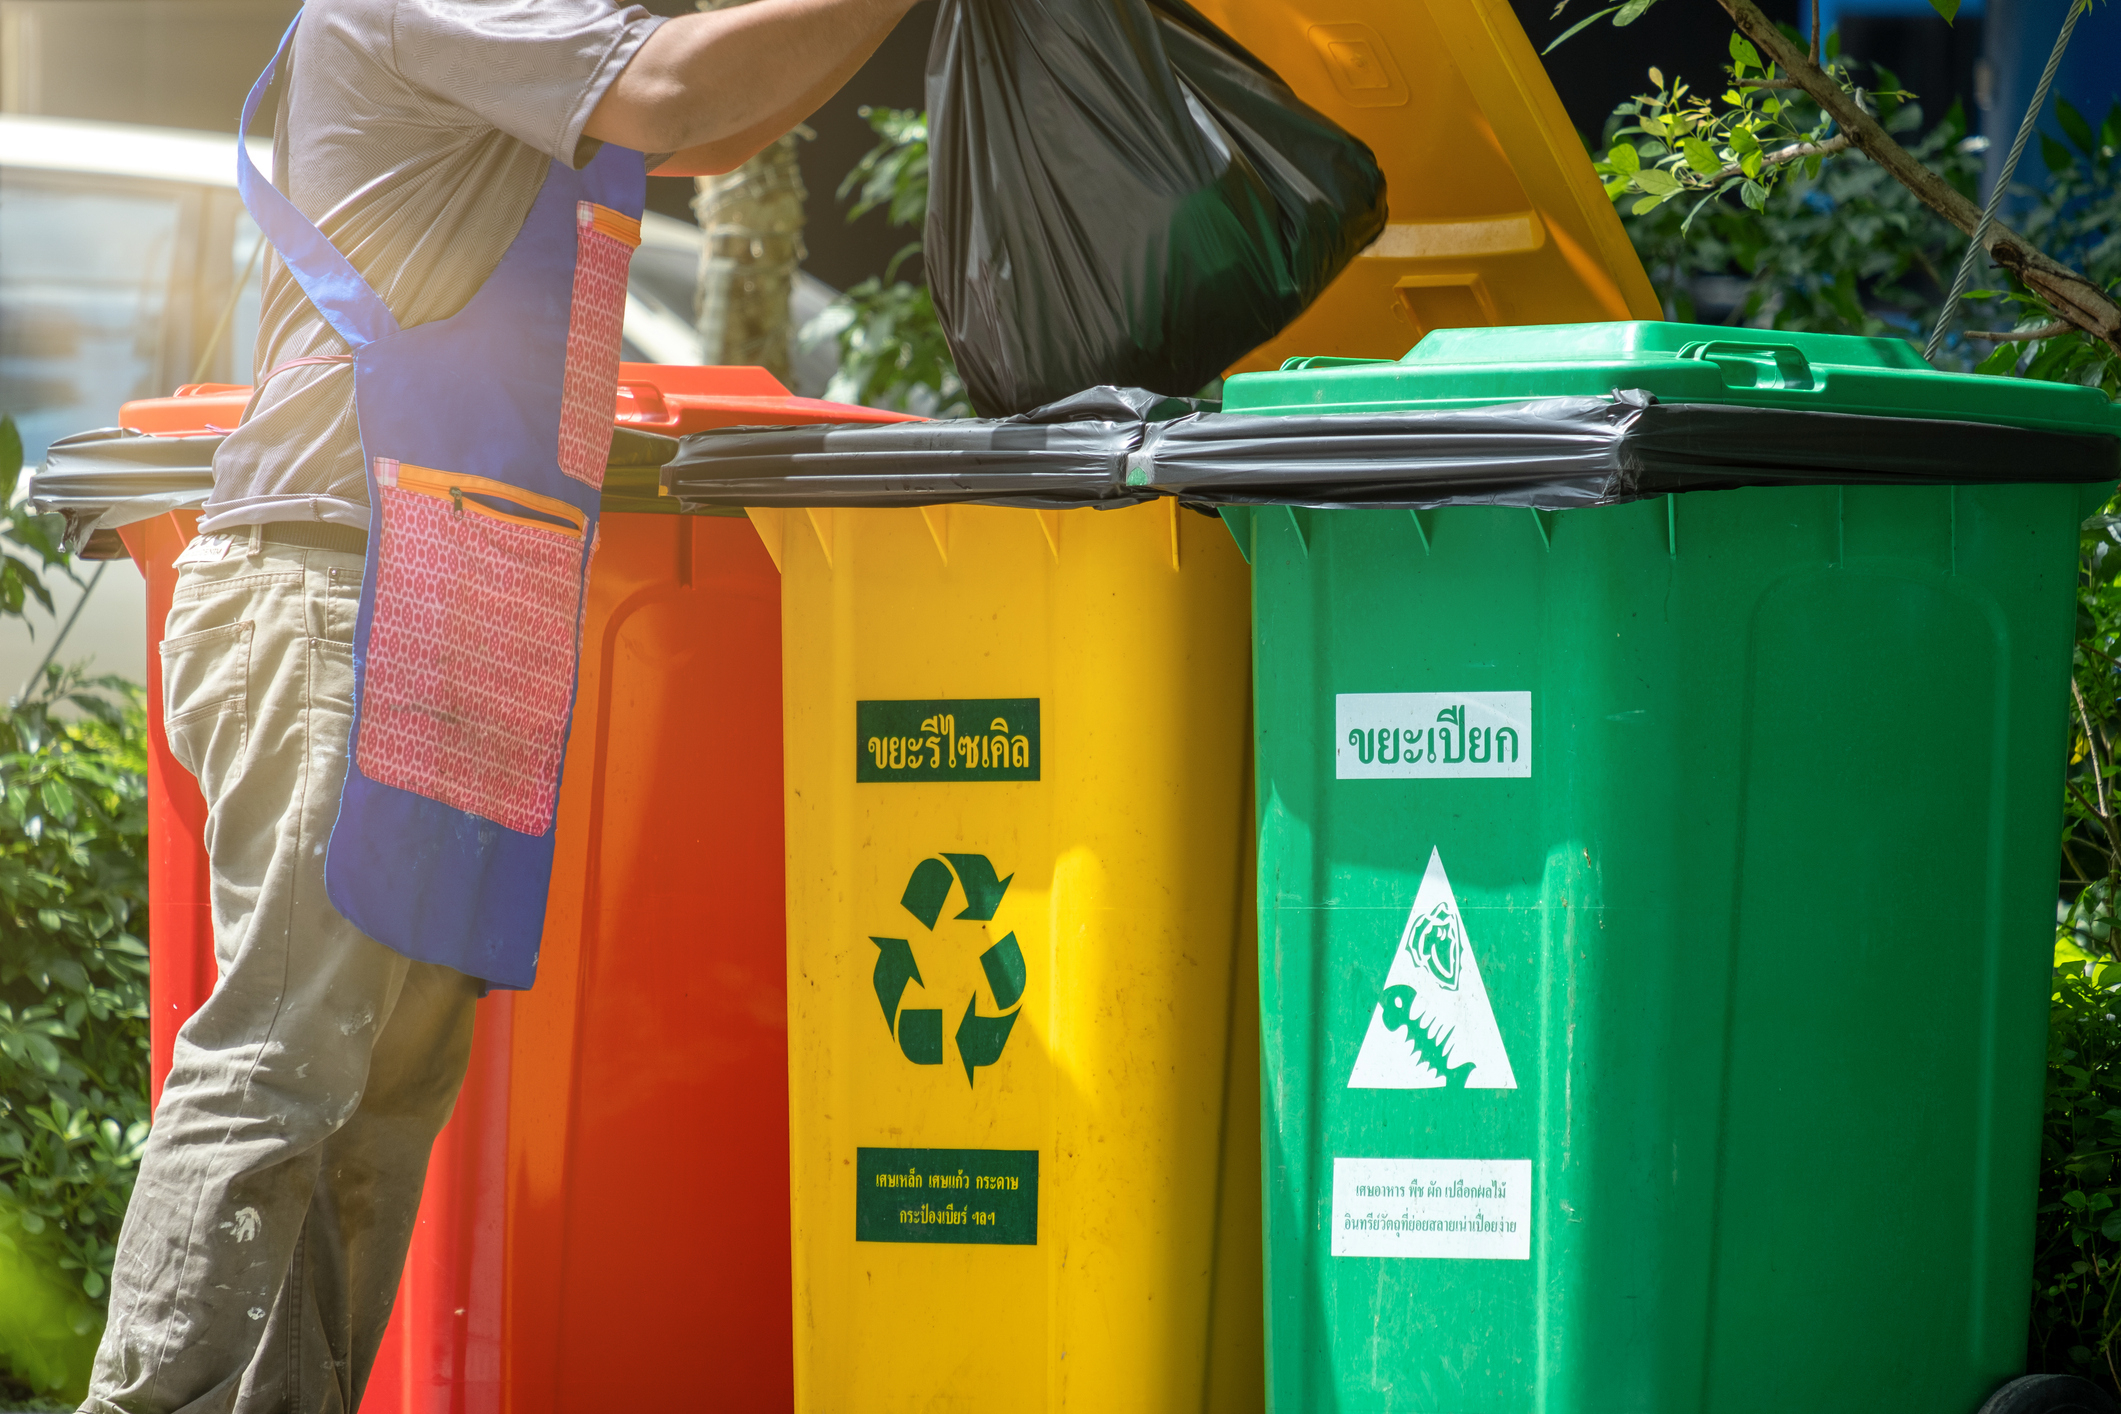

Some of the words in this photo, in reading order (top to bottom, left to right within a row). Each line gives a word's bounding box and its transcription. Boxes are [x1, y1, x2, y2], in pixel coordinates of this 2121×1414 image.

[868, 713, 1029, 769] ขยะรีไซเคิล
[1348, 704, 1519, 765] ขยะเปียก
[875, 1167, 923, 1188] เศษเหล็ก
[928, 1169, 970, 1189] เศษแก้ว
[975, 1175, 1019, 1190] กระดาษ
[1355, 1184, 1406, 1198] เศษอาหาร
[1408, 1178, 1425, 1198] พืช
[1427, 1180, 1443, 1198] ผัก
[1444, 1178, 1507, 1199] เปลือกผลไม้
[899, 1203, 968, 1225] กระป๋องเบียร์
[971, 1211, 996, 1226] ฯลฯ
